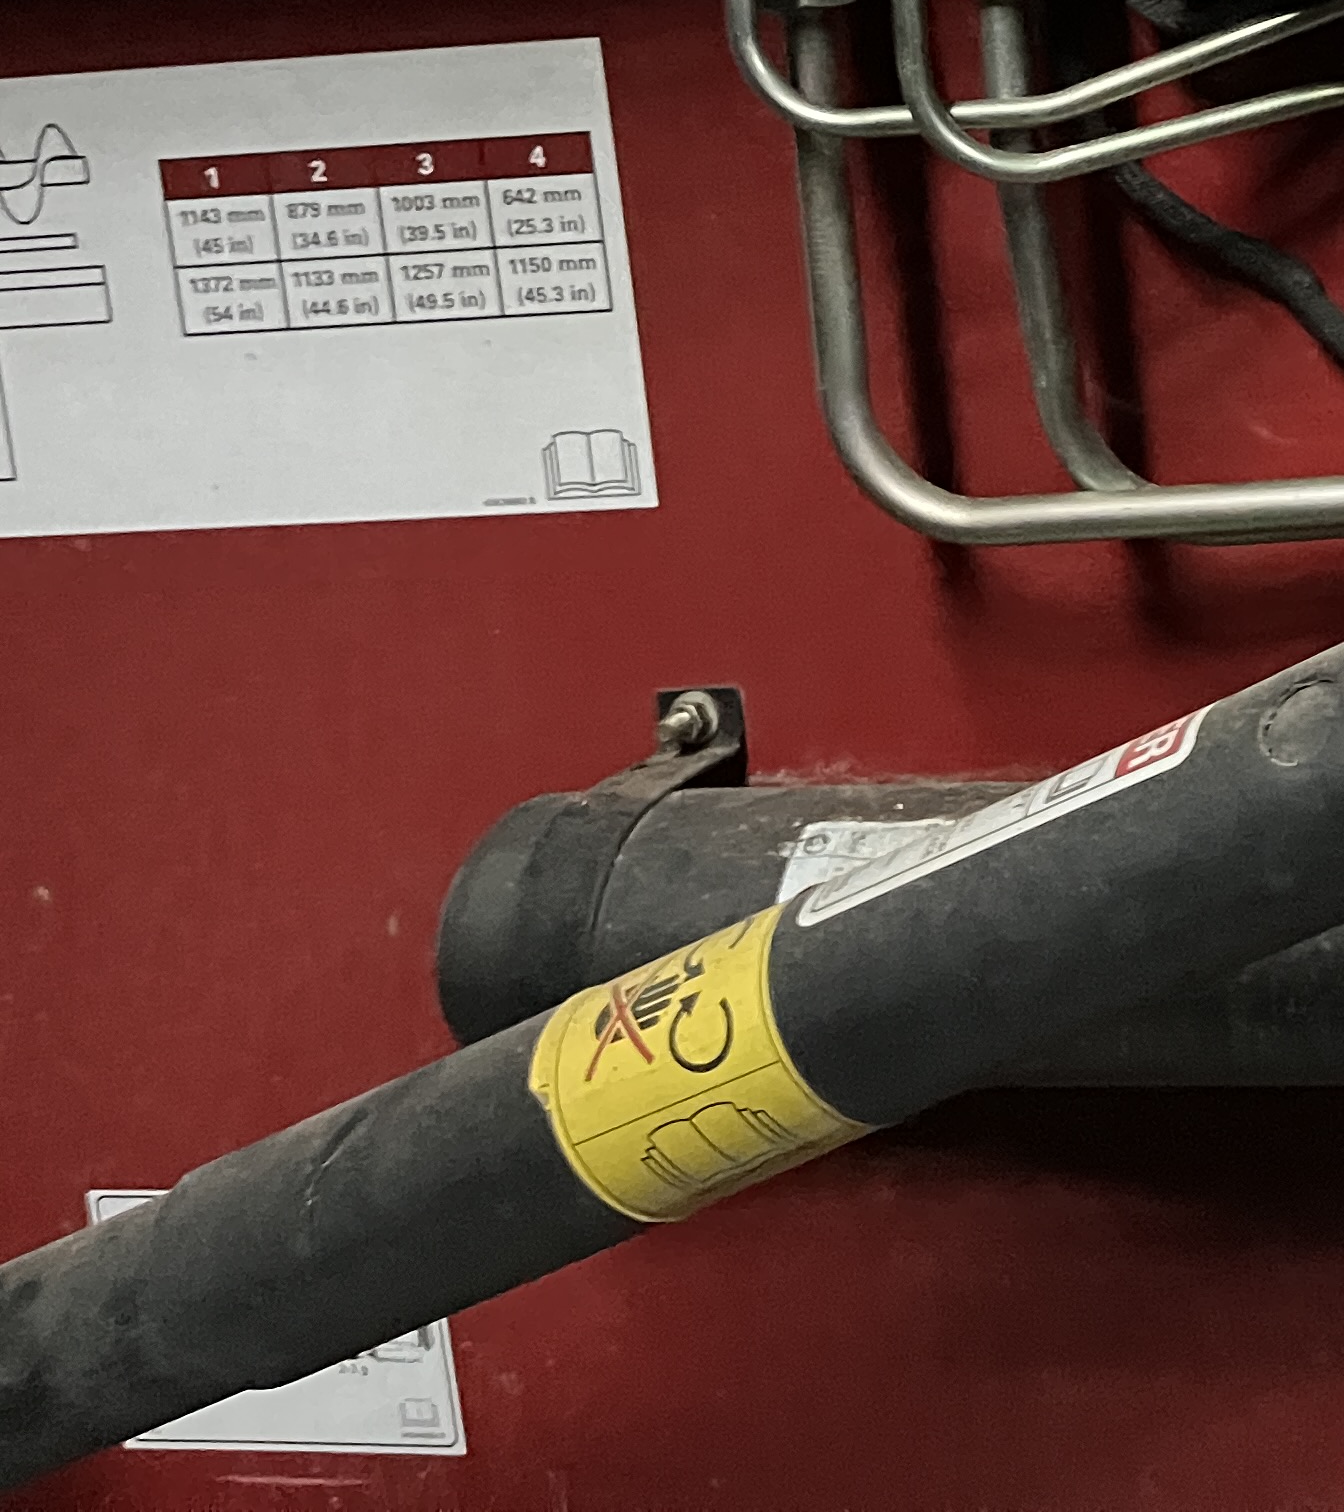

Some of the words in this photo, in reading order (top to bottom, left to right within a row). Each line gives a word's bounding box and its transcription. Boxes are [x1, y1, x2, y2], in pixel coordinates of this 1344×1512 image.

[415, 153, 434, 175] 3
[528, 145, 546, 168] 4
[204, 167, 220, 189] 1
[307, 158, 328, 182] 2
[391, 194, 435, 212] 1003
[441, 194, 480, 209] mm
[503, 188, 537, 205] 642
[543, 189, 582, 203] mm
[450, 220, 477, 241] in)
[507, 217, 554, 237] (25.3
[559, 214, 586, 234] in)
[400, 263, 445, 281] 1257
[451, 264, 490, 279] mm
[508, 257, 552, 274] 1150
[558, 257, 597, 272] mm
[291, 270, 335, 287] 1133
[340, 271, 379, 284] mm
[459, 289, 486, 310] in)
[518, 285, 565, 306] (45.3
[570, 282, 596, 303] in)
